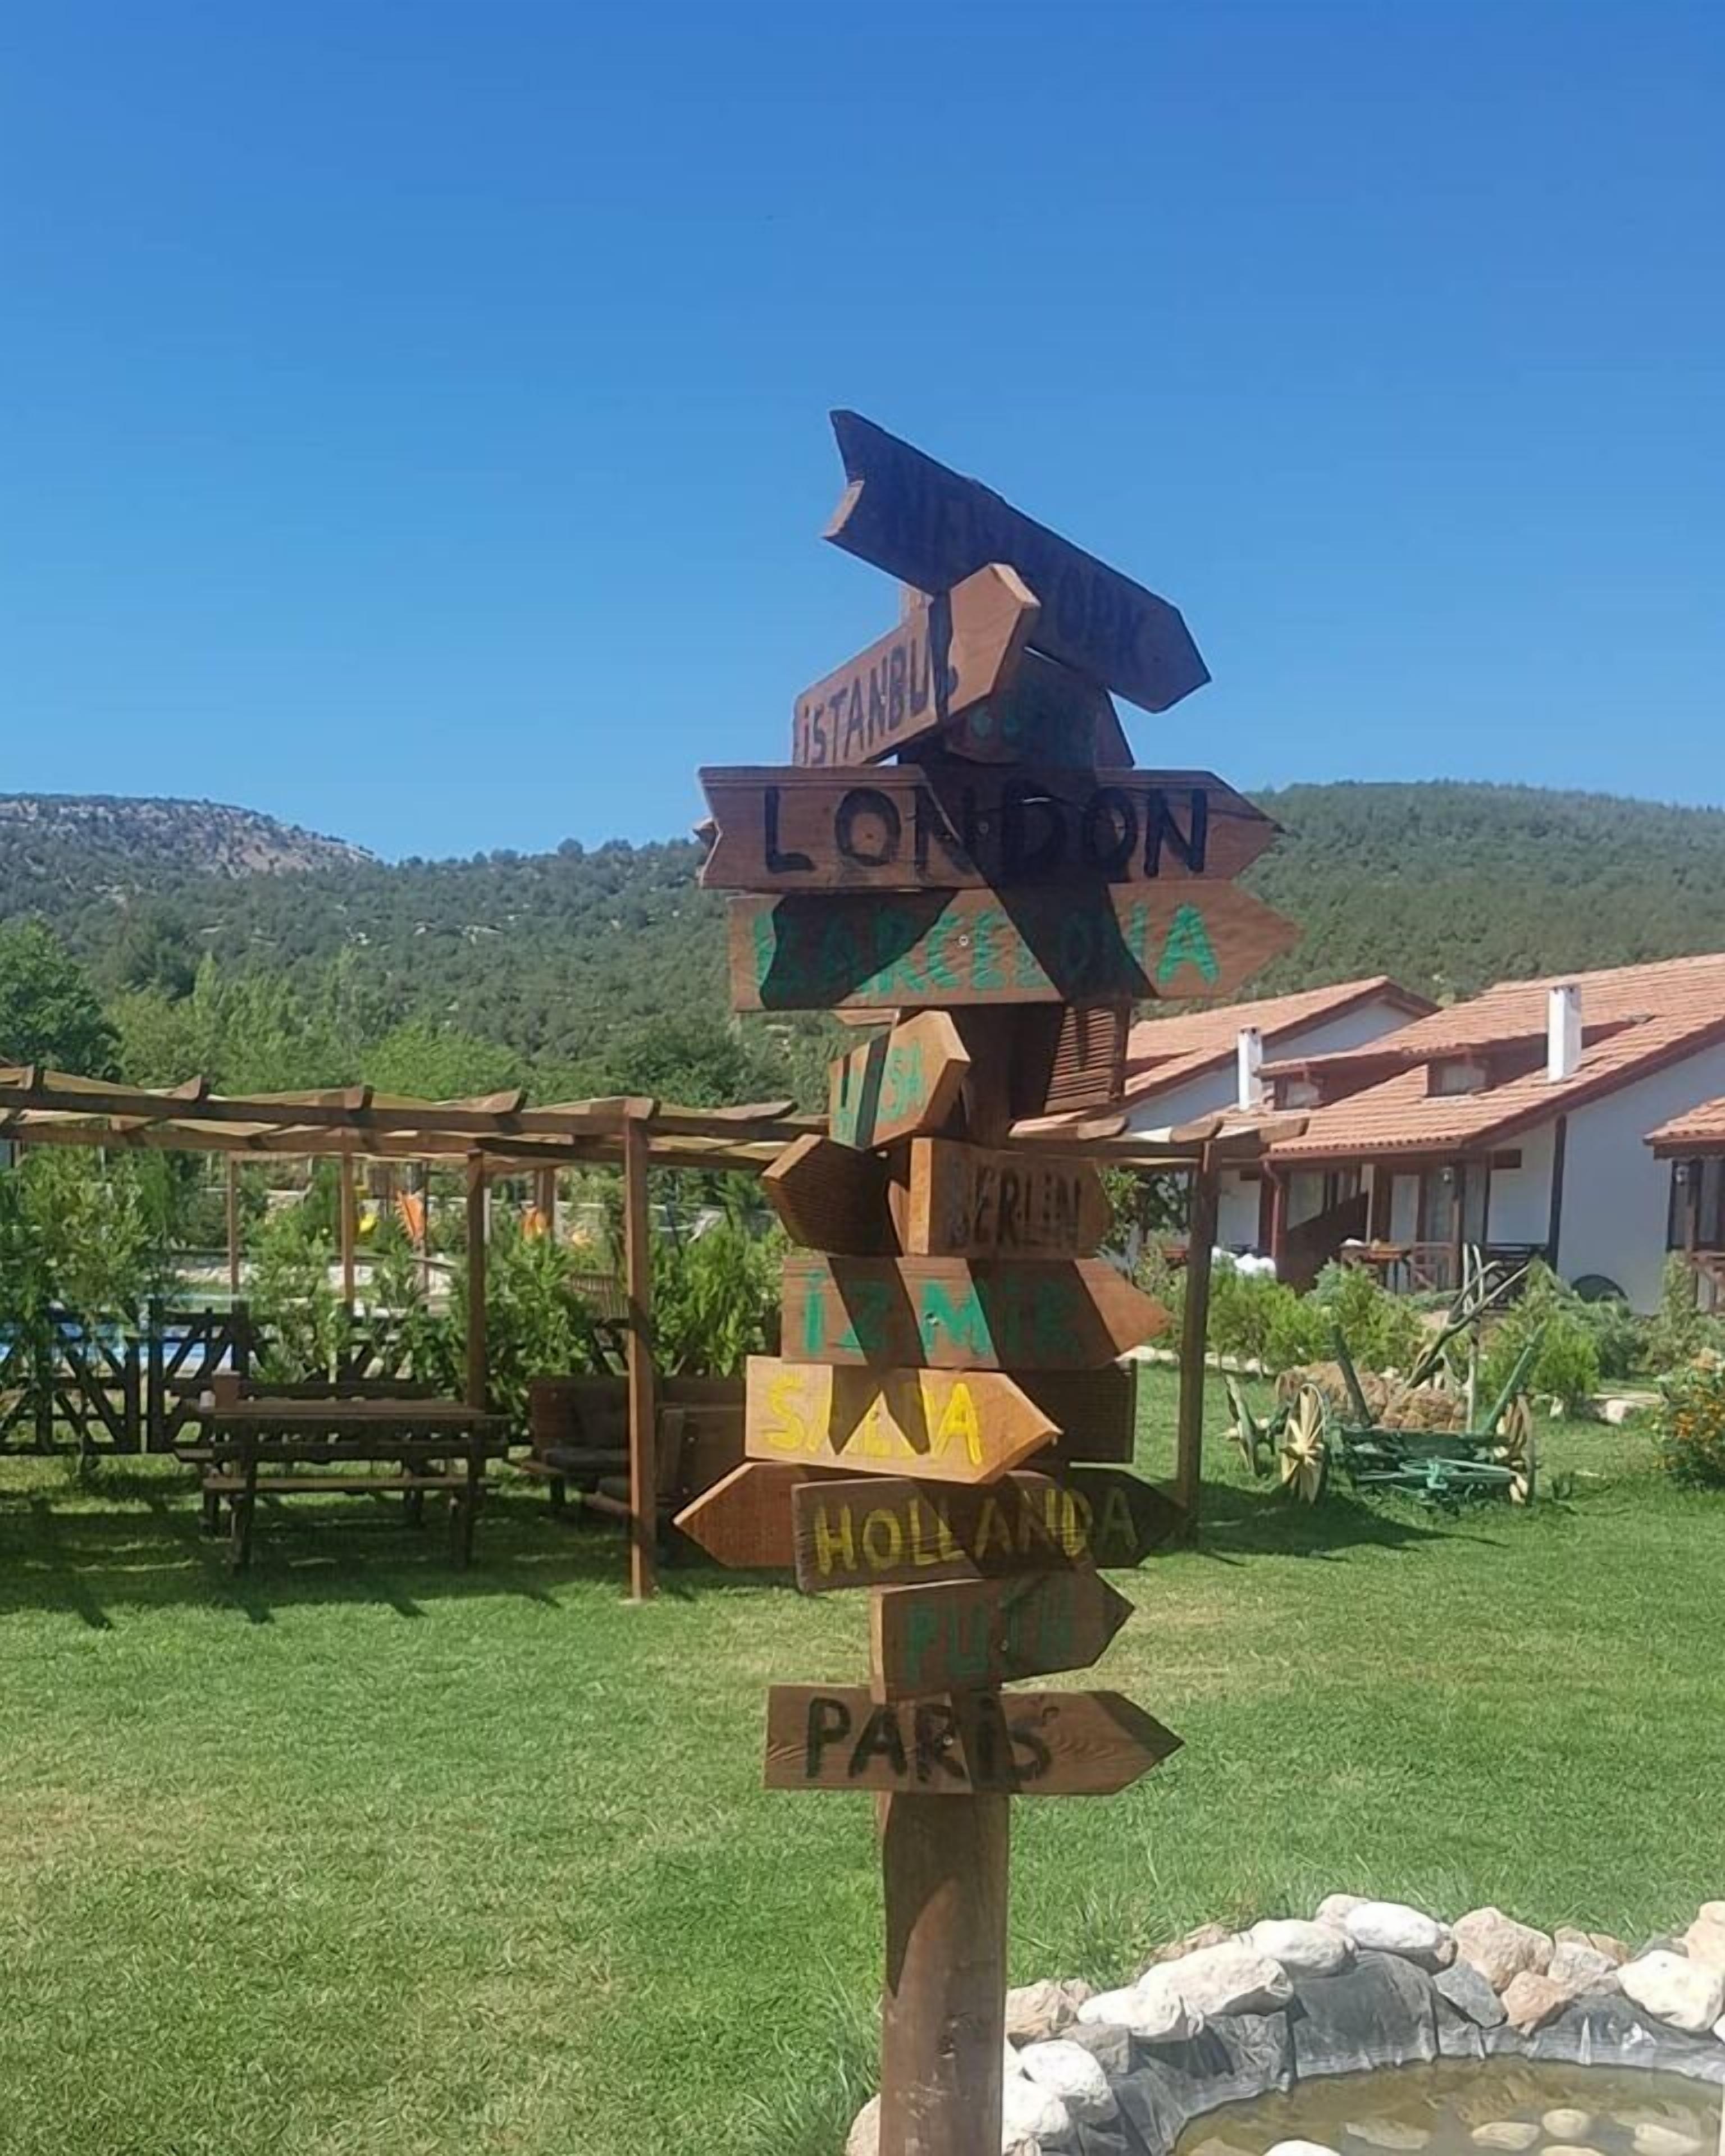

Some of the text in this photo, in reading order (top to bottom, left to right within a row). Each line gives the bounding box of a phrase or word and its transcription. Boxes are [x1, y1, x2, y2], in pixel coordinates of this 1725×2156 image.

[765, 786, 1207, 879] LONDON
[754, 901, 1221, 997] BARCELONA
[814, 1486, 1138, 1574] HOLLANDA
